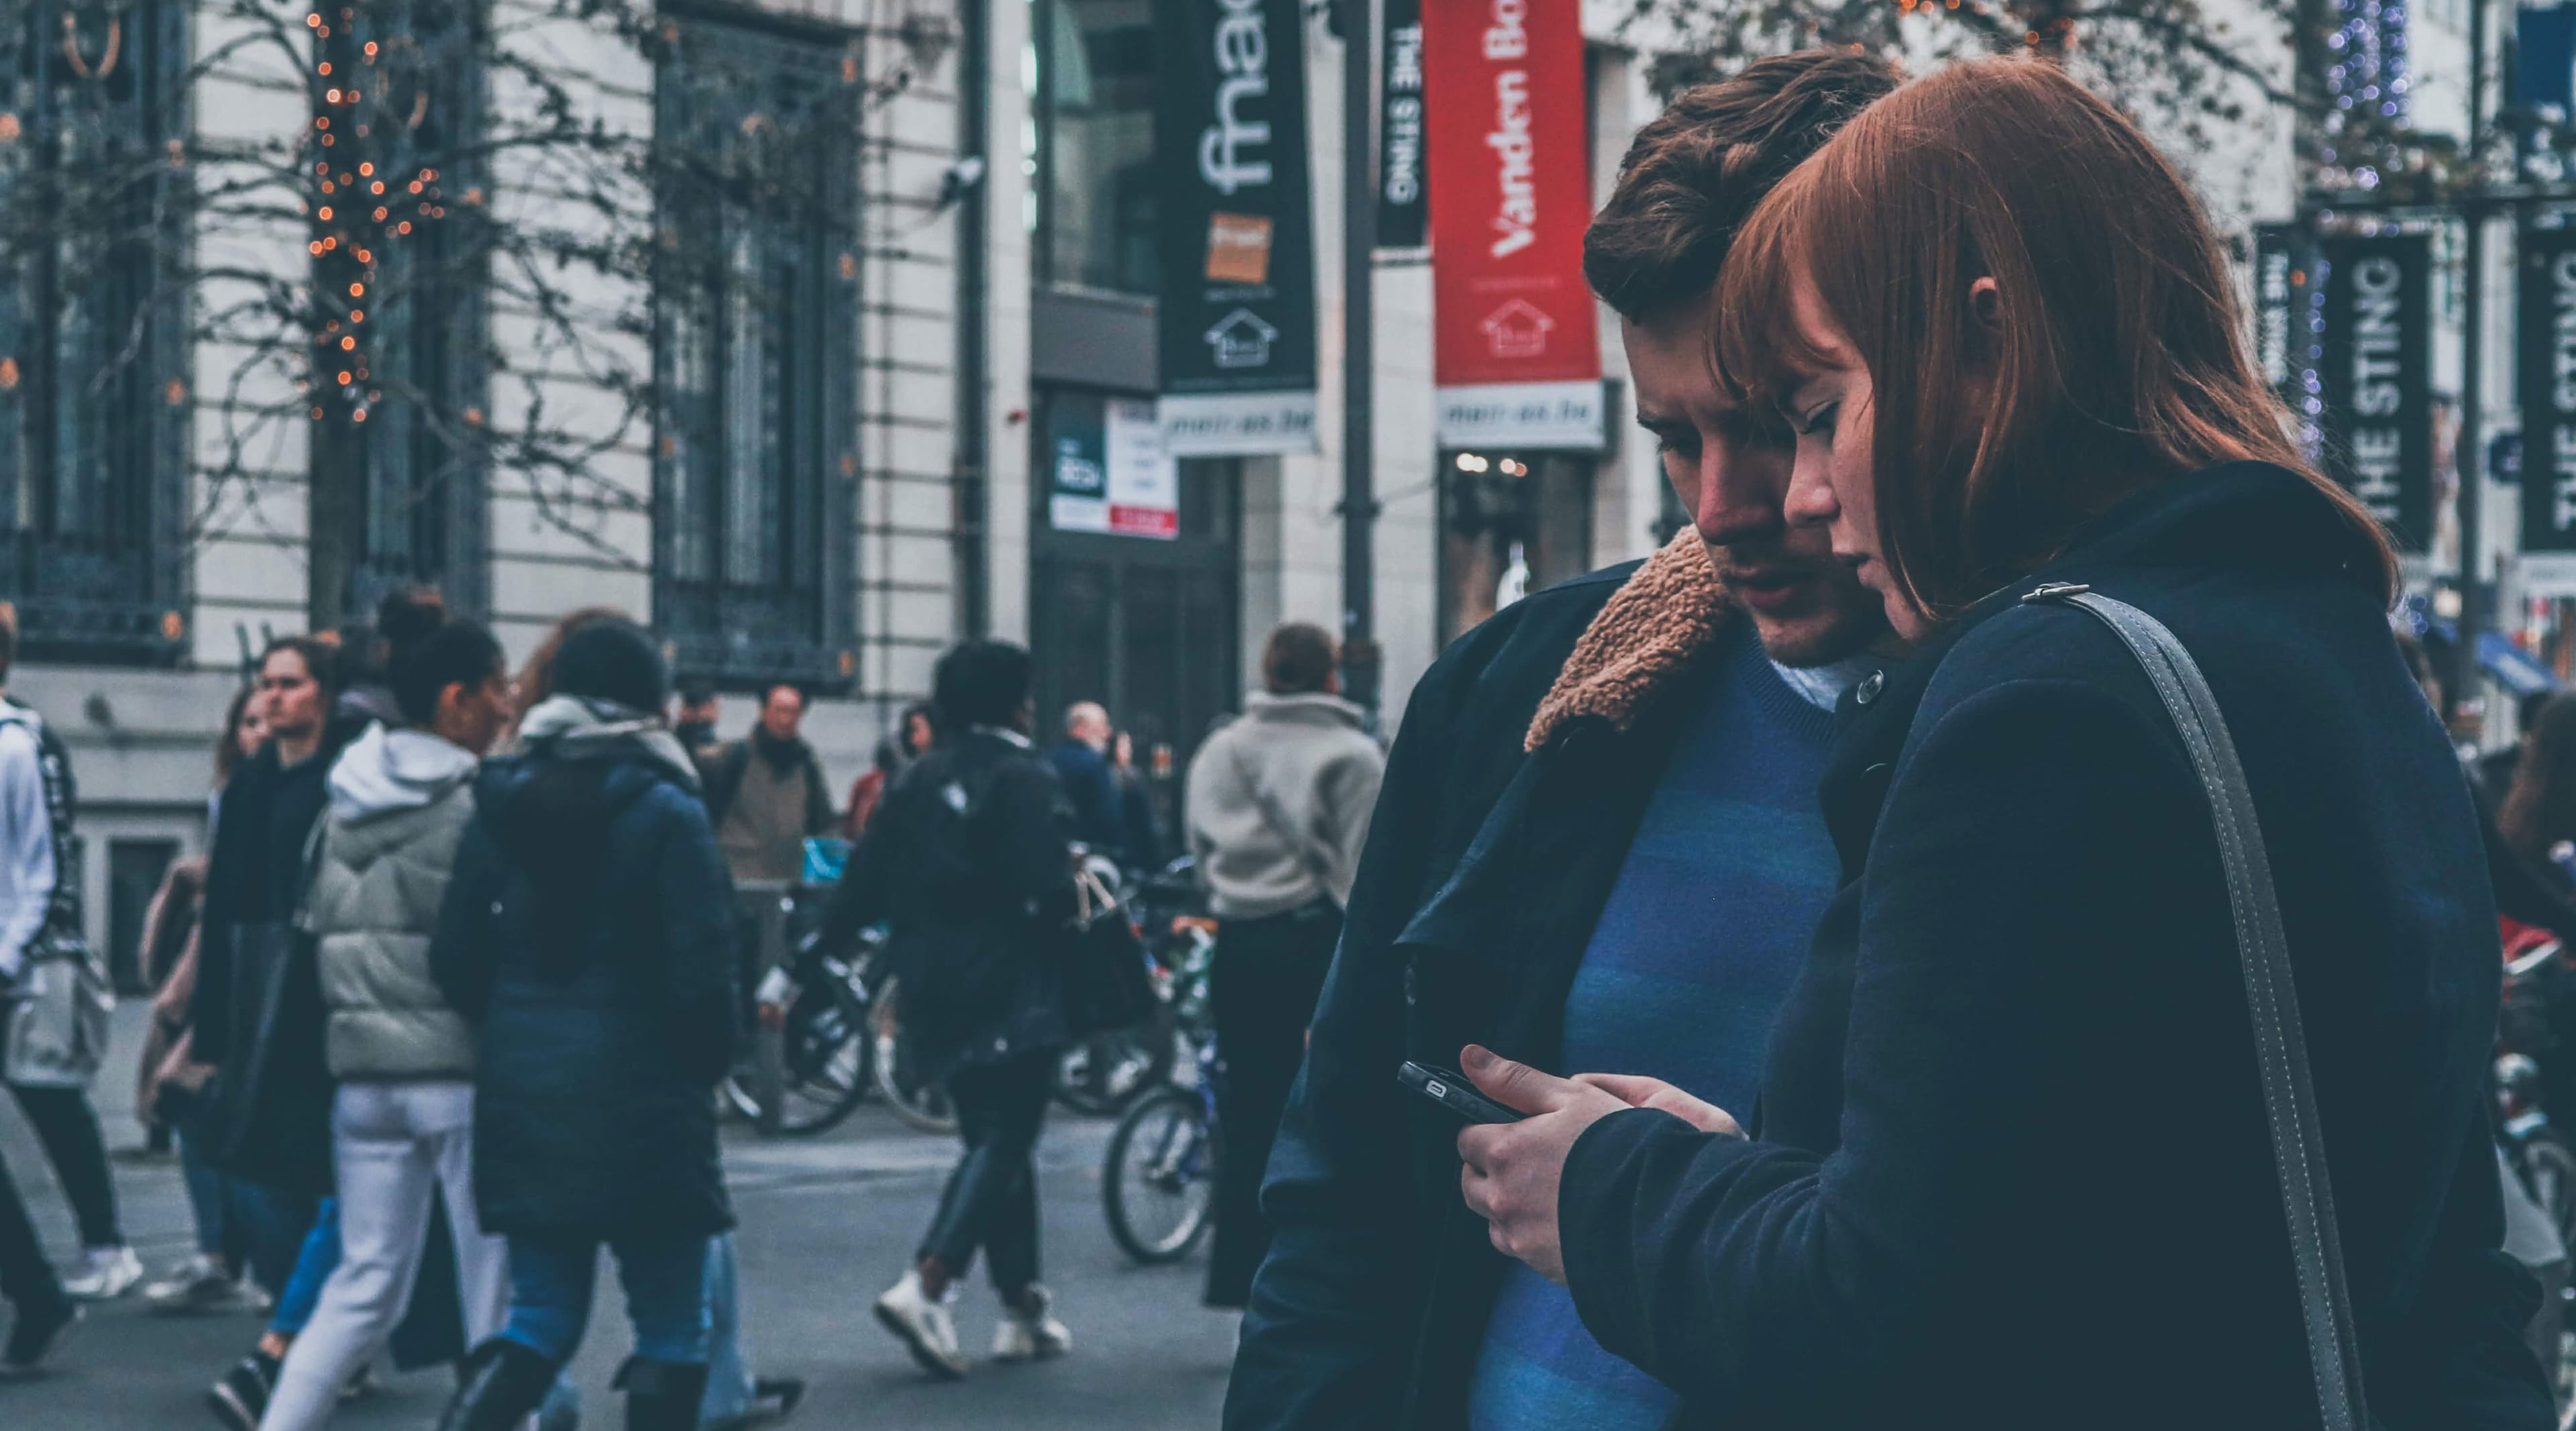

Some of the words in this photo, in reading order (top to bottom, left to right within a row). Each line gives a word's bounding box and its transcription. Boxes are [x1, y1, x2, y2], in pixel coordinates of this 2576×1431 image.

[1198, 0, 1271, 195] fna
[1389, 23, 1423, 91] THE
[1385, 97, 1421, 205] STING
[1485, 71, 1536, 258] Vanden
[2353, 257, 2401, 415] STING
